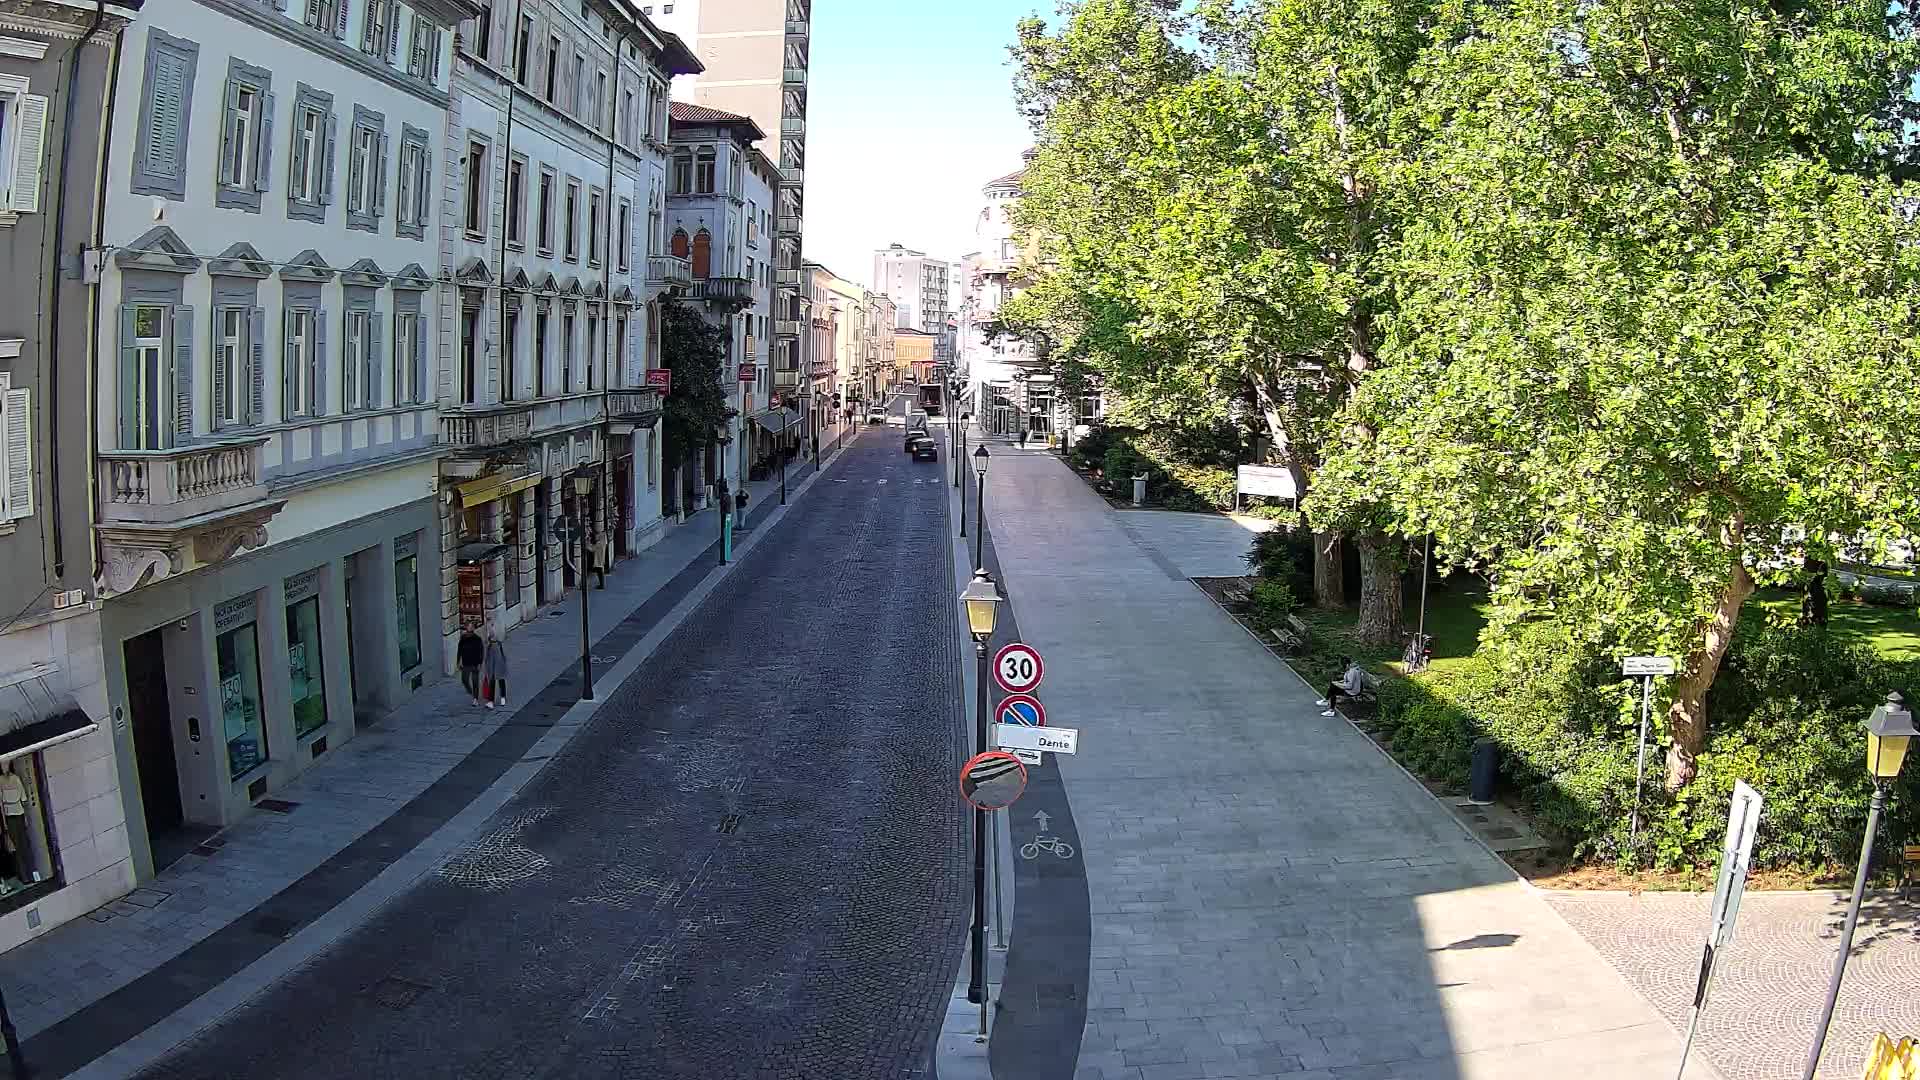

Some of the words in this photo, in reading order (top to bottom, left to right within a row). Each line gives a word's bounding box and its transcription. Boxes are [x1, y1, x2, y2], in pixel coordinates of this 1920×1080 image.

[1005, 657, 1033, 680] 30
[222, 680, 240, 700] 130
[1038, 737, 1070, 749] Dante
